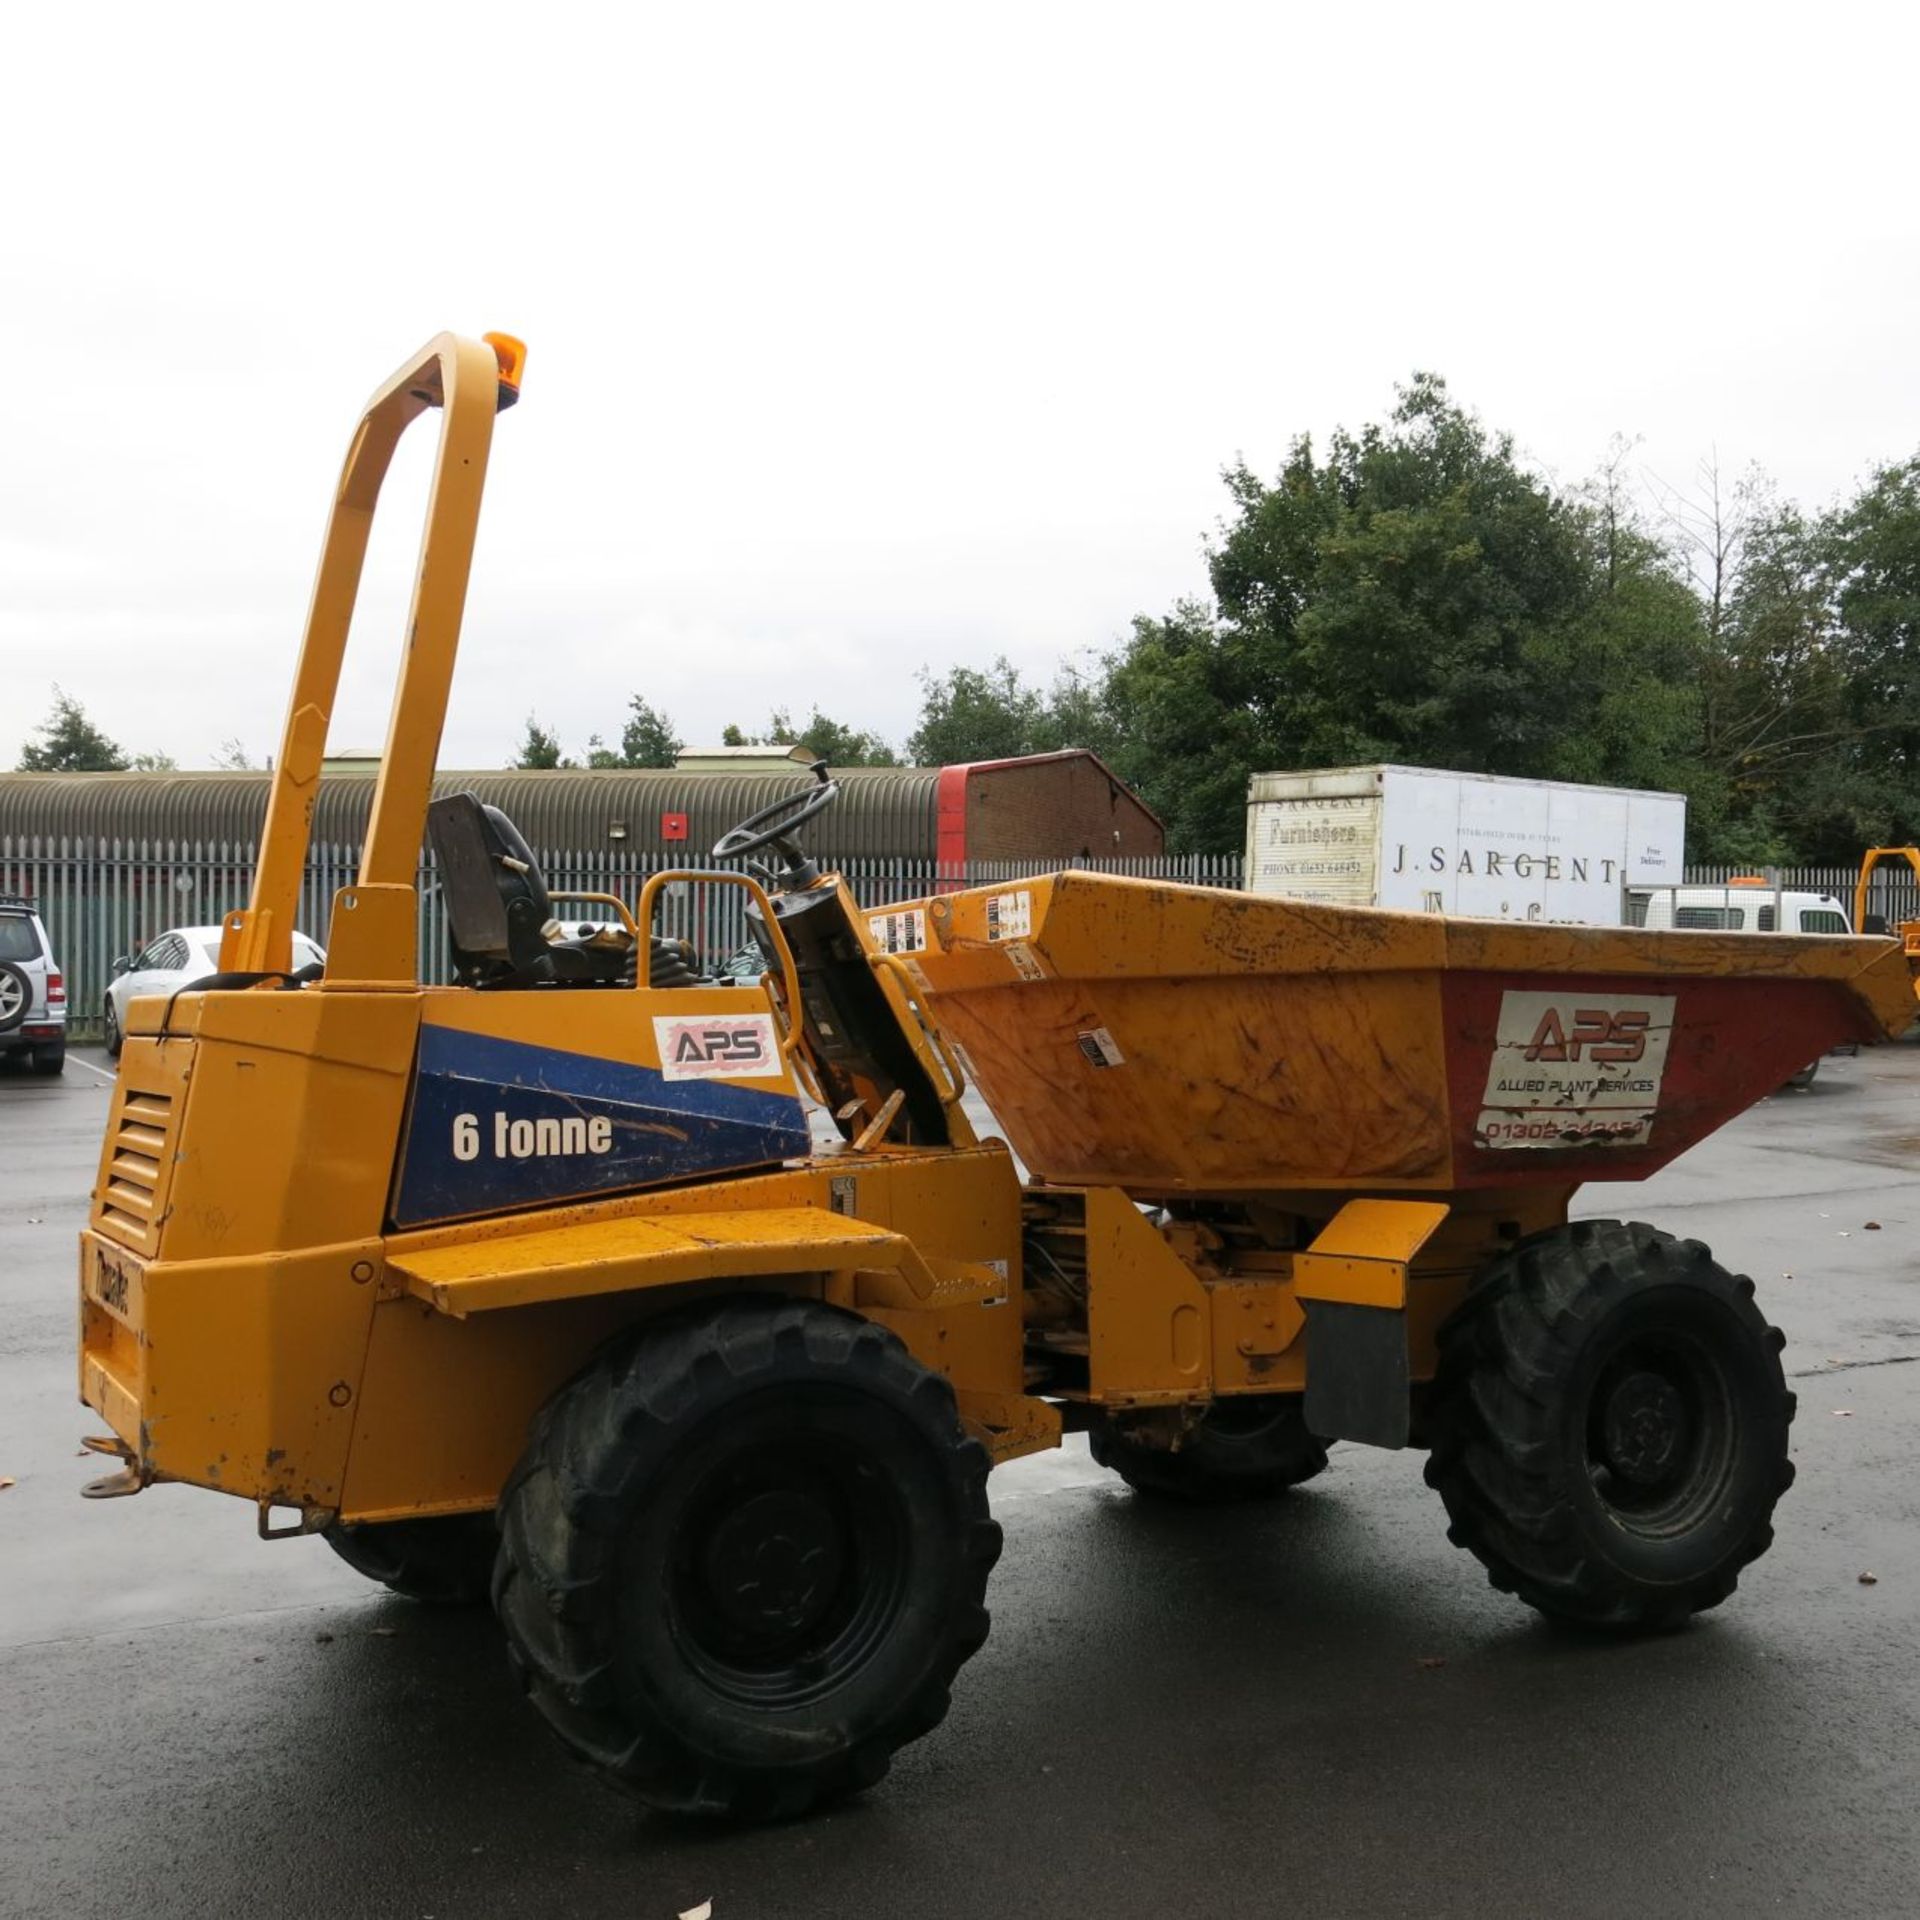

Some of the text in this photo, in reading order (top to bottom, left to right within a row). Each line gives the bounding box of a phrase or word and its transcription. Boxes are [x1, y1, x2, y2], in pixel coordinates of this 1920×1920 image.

[675, 1029, 763, 1063] APS
[1524, 1007, 1650, 1063] APS
[1497, 1080, 1545, 1092] ALLIED
[1548, 1080, 1593, 1093] PLANT
[453, 1111, 612, 1161] 6 tonne
